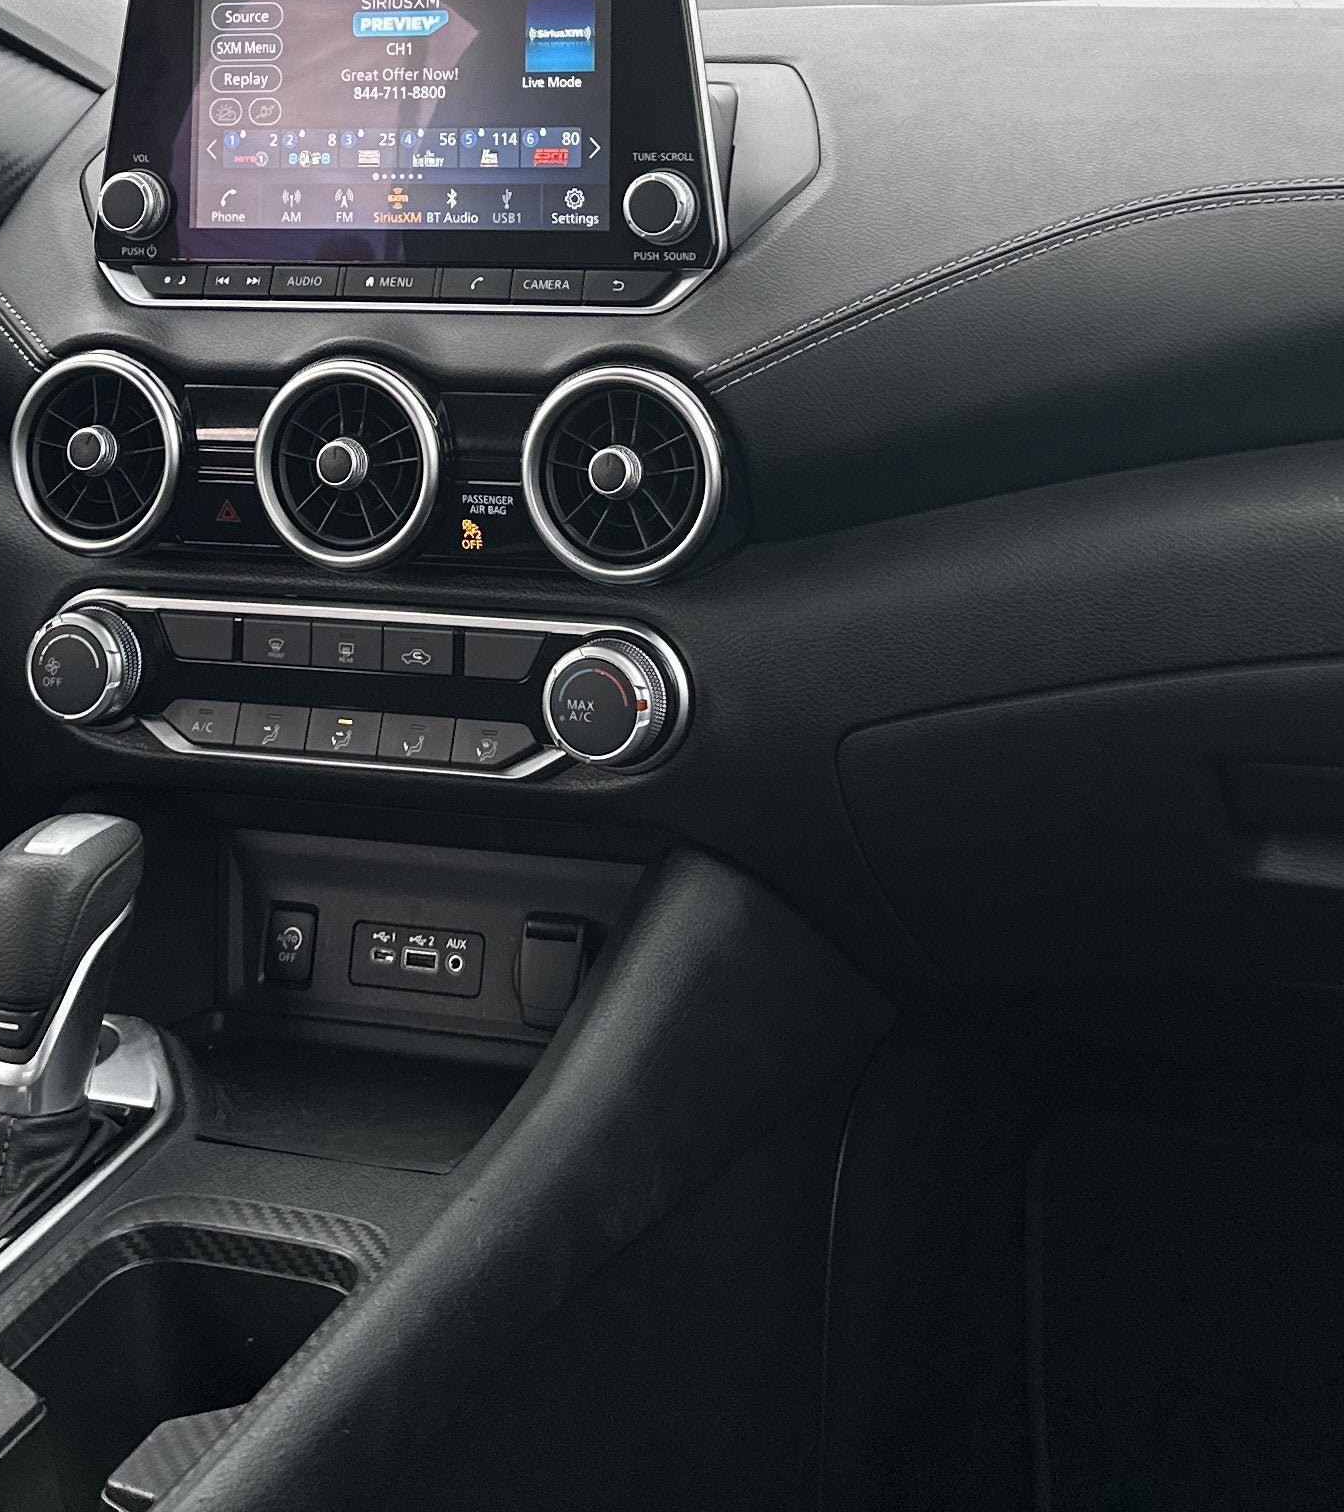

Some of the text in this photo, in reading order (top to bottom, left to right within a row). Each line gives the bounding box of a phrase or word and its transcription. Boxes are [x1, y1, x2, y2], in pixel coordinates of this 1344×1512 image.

[225, 10, 270, 23] Source
[360, 16, 441, 31] PREVIEW
[217, 41, 276, 54] SXM Menu
[386, 42, 413, 56] CH1
[224, 73, 268, 88] Replay
[341, 67, 459, 82] Great Offer Now!
[522, 76, 582, 89] Live Mode
[353, 87, 446, 100] 844-711-8800
[229, 135, 236, 145] 1
[269, 134, 278, 147] 2
[286, 135, 294, 146] 2
[327, 133, 337, 147] 8
[345, 135, 353, 146] 3
[379, 133, 396, 147] 25
[404, 134, 412, 145] 4
[439, 133, 457, 146] 56
[465, 134, 473, 145] 5
[492, 132, 518, 146] 114
[527, 133, 534, 144] 6
[561, 132, 580, 146] 80
[133, 154, 150, 163] VOL
[212, 211, 246, 223] Phone
[281, 212, 301, 222] AM
[336, 212, 353, 222] FM
[374, 212, 422, 223] SiriusXM
[427, 212, 479, 224] BT Audio
[492, 213, 521, 224] USB1
[551, 213, 599, 227] Settings
[122, 247, 145, 256] PUSH
[633, 251, 697, 261] PUSH SOUND
[287, 275, 323, 287] AUDIO
[379, 276, 414, 288] MENU
[523, 279, 570, 290] CAMERA
[462, 494, 514, 506] PASSENGER
[469, 505, 507, 515] AIR BAG
[461, 539, 484, 550] OFF
[42, 677, 63, 688] OFF
[567, 698, 595, 712] MAX
[569, 710, 592, 723] A/C
[191, 720, 215, 734] A/C
[428, 936, 435, 947] 2
[445, 938, 467, 950] AUX
[278, 951, 296, 963] OFF
